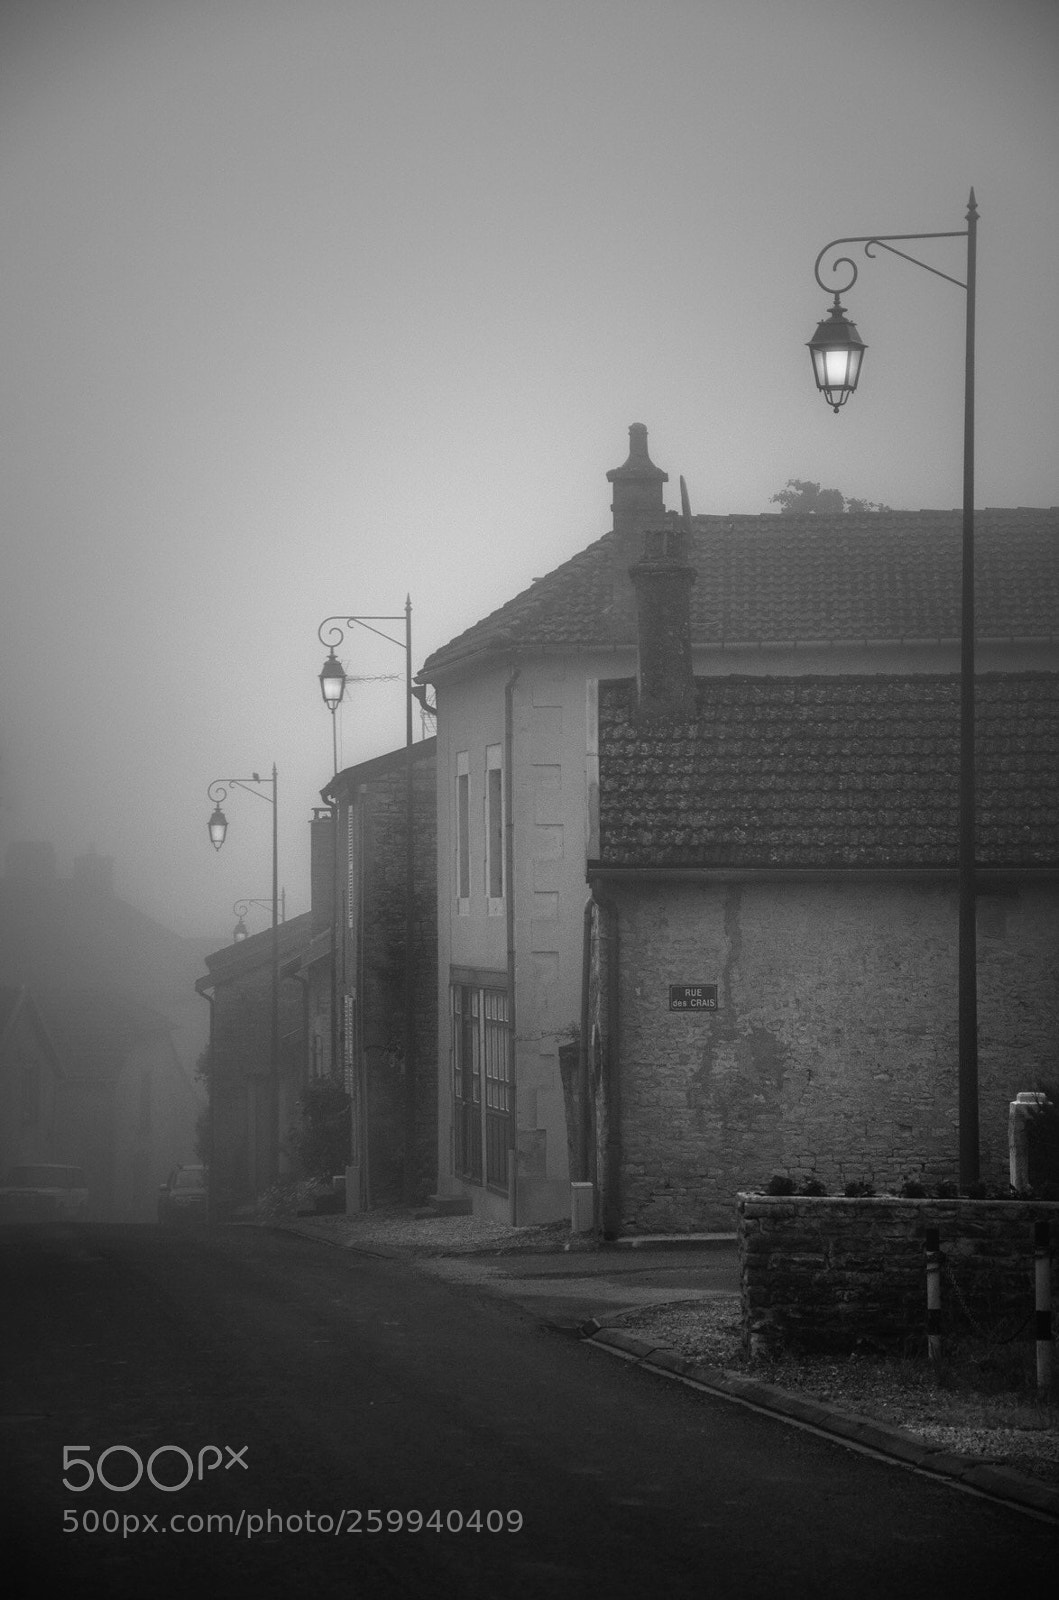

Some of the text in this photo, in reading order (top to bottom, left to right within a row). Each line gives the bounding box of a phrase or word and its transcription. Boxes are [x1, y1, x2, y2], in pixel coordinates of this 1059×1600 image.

[685, 988, 702, 996] RUE
[672, 998, 715, 1007] des CRAIS
